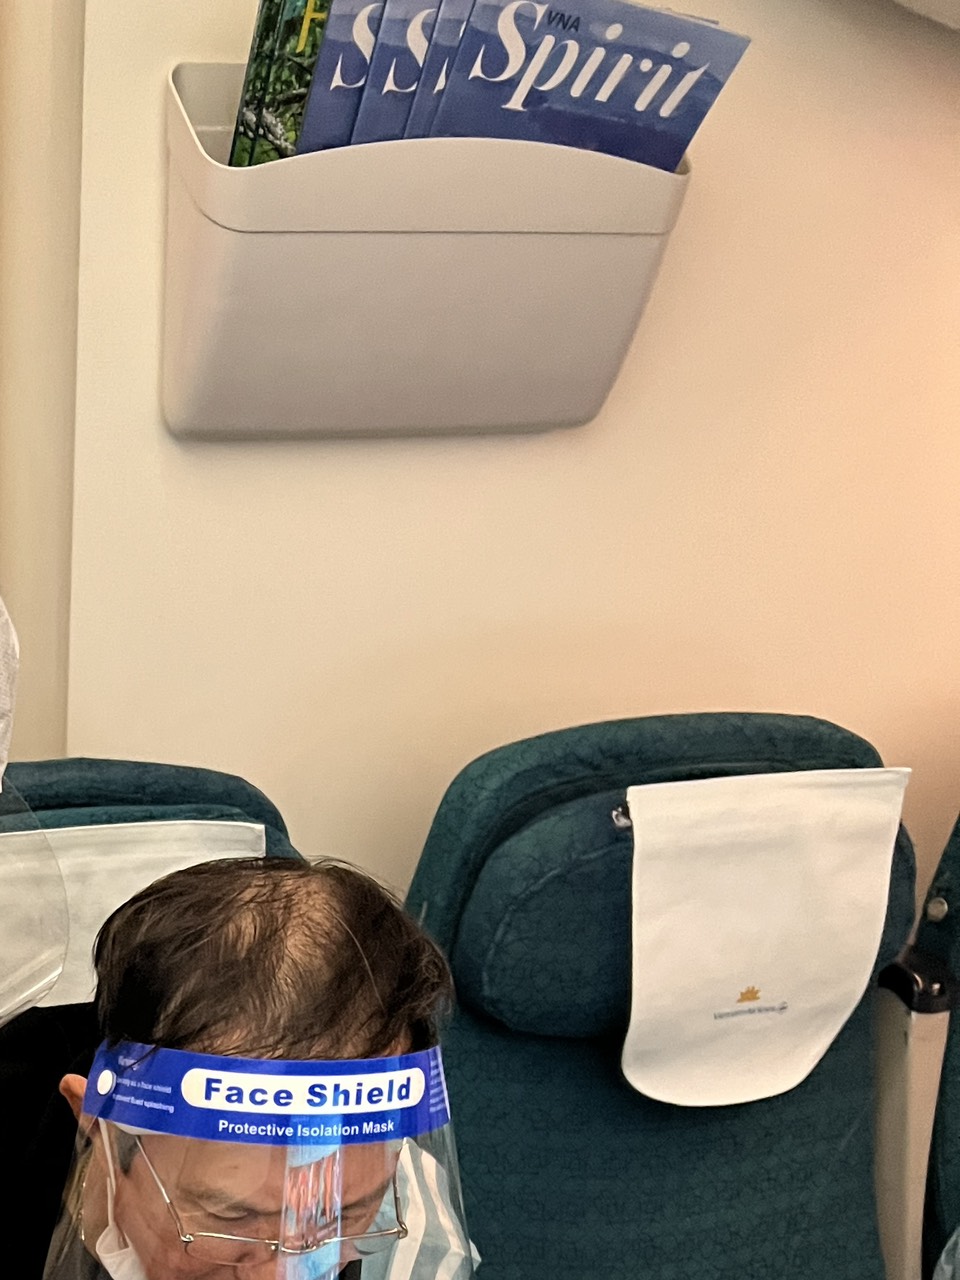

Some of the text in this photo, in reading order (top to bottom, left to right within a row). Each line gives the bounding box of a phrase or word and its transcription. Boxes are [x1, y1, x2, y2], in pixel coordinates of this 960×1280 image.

[547, 10, 581, 32] VNA
[469, 0, 709, 117] Spirit
[205, 1077, 293, 1107] Face
[307, 1077, 412, 1107] Shield
[219, 1119, 394, 1137] Protective Isolation Mask
